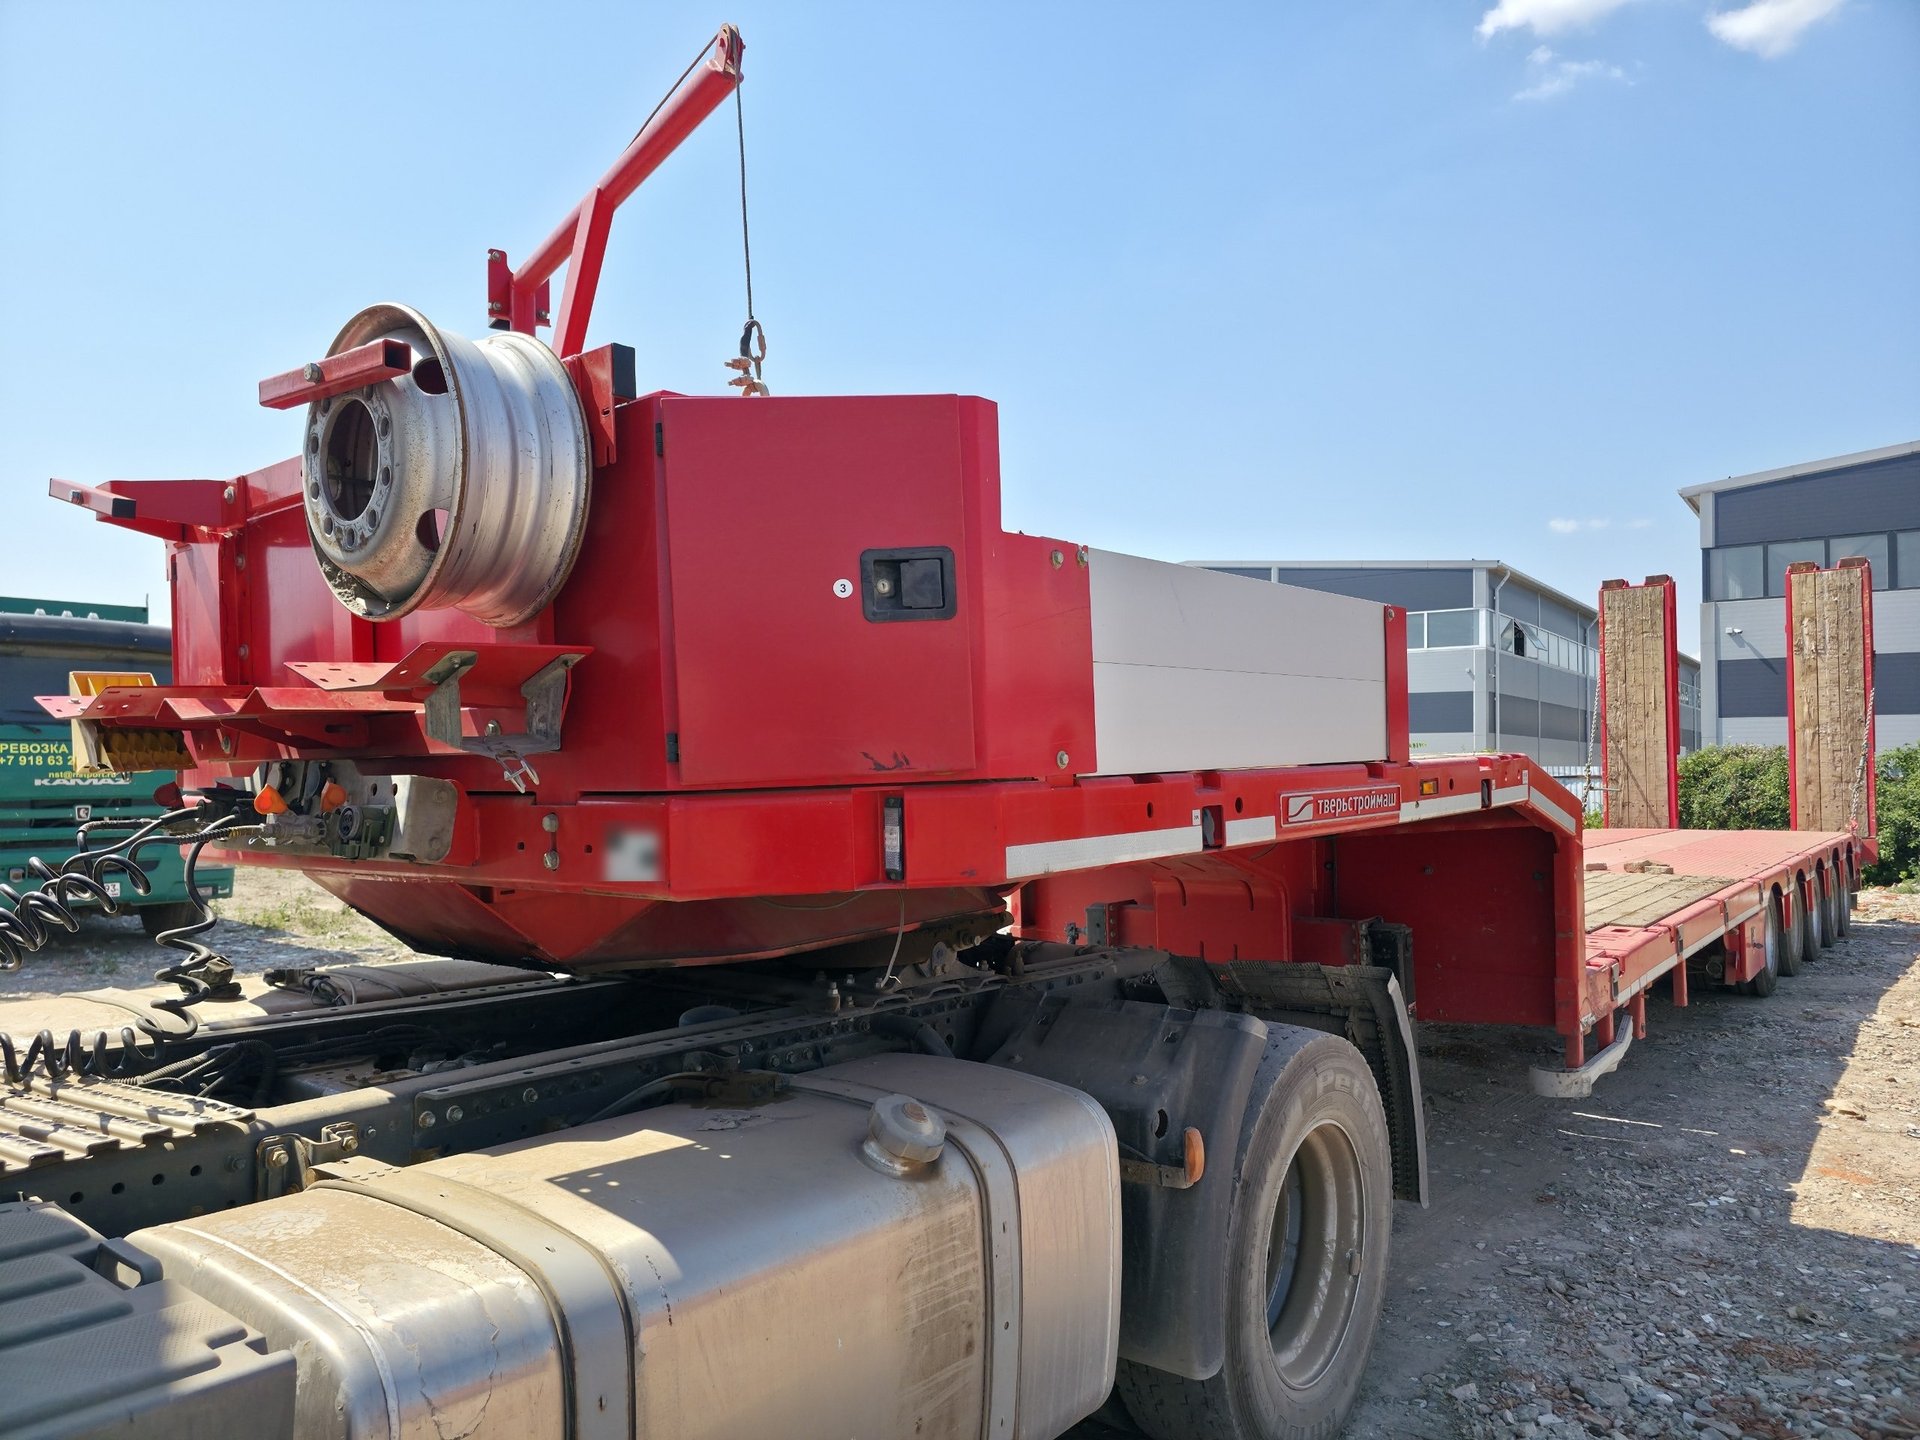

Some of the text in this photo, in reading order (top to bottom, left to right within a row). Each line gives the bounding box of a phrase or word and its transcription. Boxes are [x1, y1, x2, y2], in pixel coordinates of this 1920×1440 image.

[840, 583, 847, 593] 3
[0, 743, 68, 753] РЕВОЗКА
[0, 756, 14, 765] +7
[19, 755, 43, 766] 918
[47, 755, 64, 766] 63
[1317, 791, 1397, 817] тверьстроймаш
